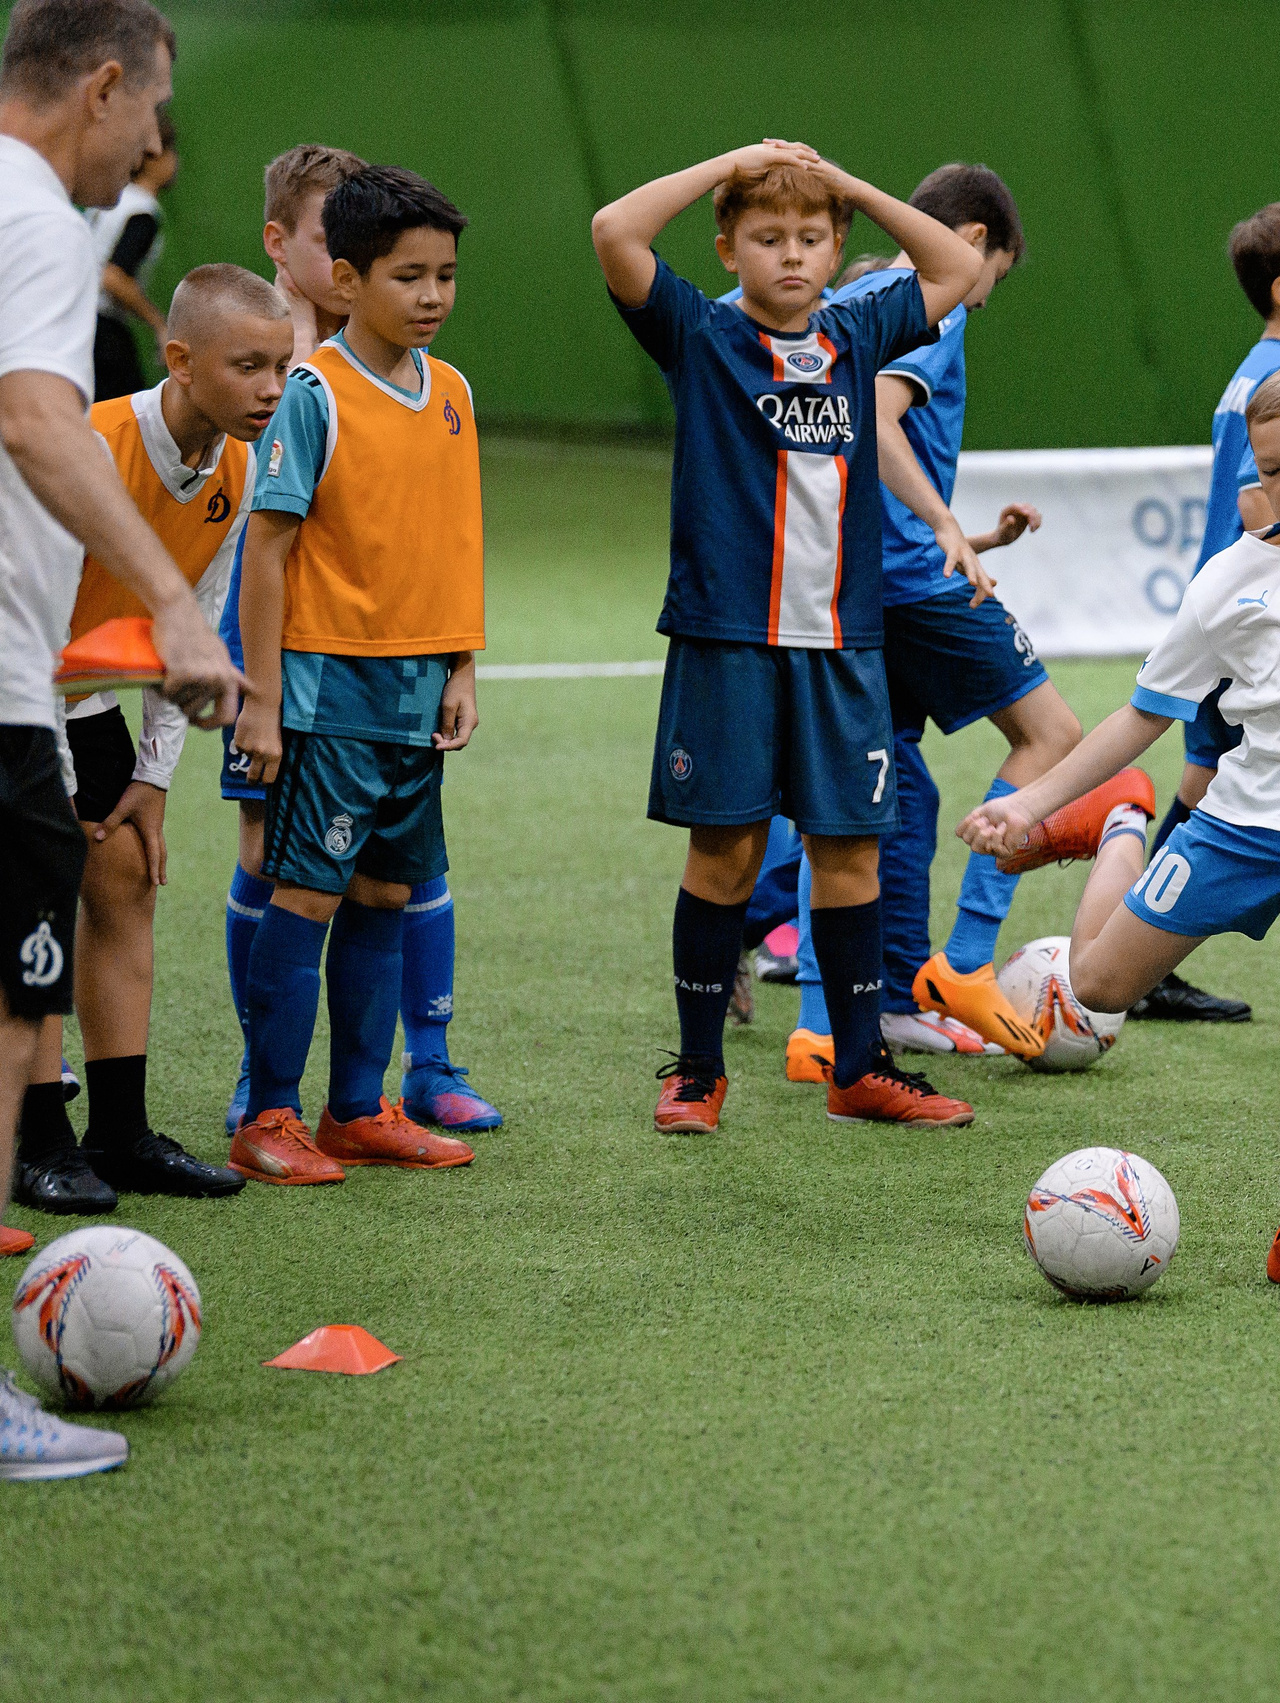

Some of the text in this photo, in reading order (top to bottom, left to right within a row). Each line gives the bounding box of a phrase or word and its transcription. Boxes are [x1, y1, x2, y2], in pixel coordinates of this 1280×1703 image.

[756, 394, 851, 429] QATAR
[867, 748, 889, 803] 7
[1133, 845, 1191, 913] 10
